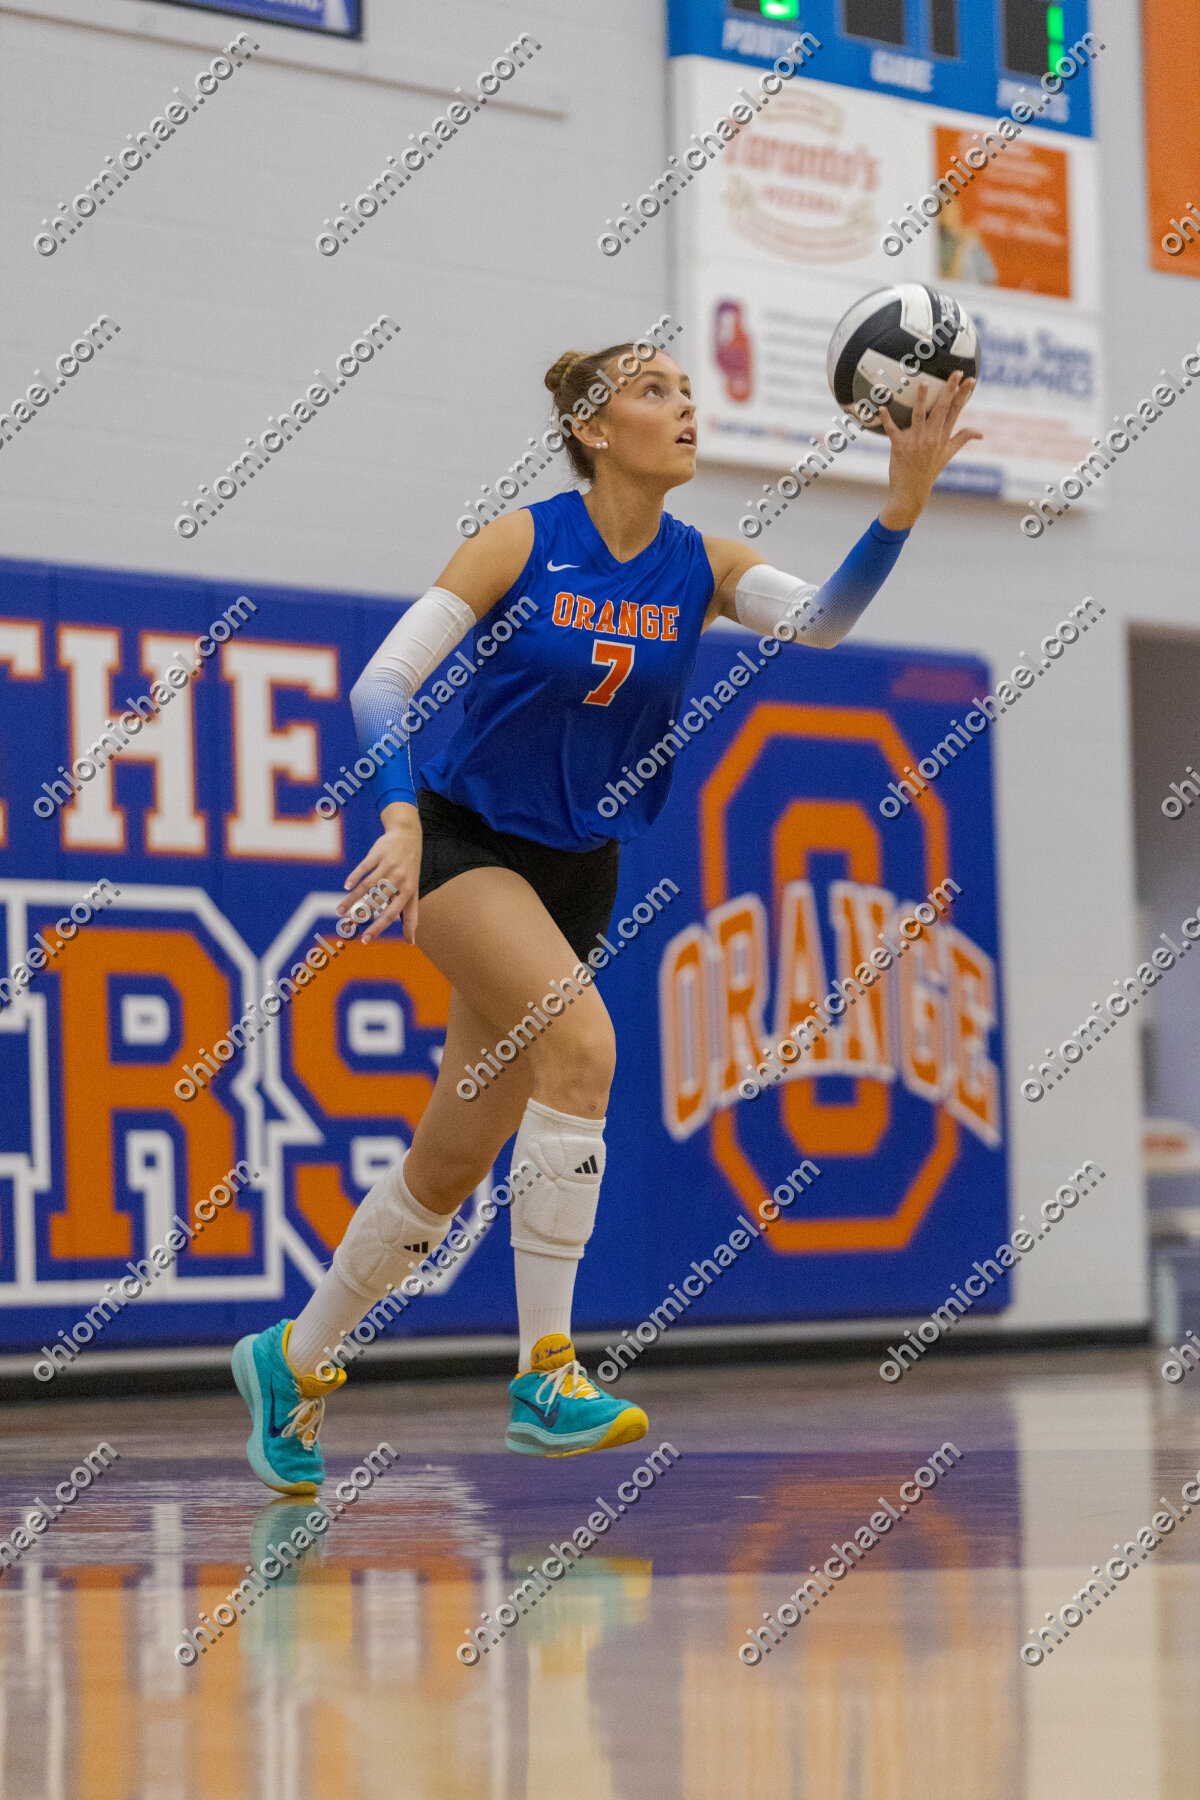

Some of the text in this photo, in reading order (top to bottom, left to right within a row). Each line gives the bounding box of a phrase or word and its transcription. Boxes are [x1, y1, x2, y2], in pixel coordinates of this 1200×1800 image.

[0, 615, 345, 863] HE
[551, 591, 680, 641] ORANGE
[582, 638, 636, 707] 7
[0, 878, 490, 1304] RS
[658, 879, 1001, 1142] ORANGE
